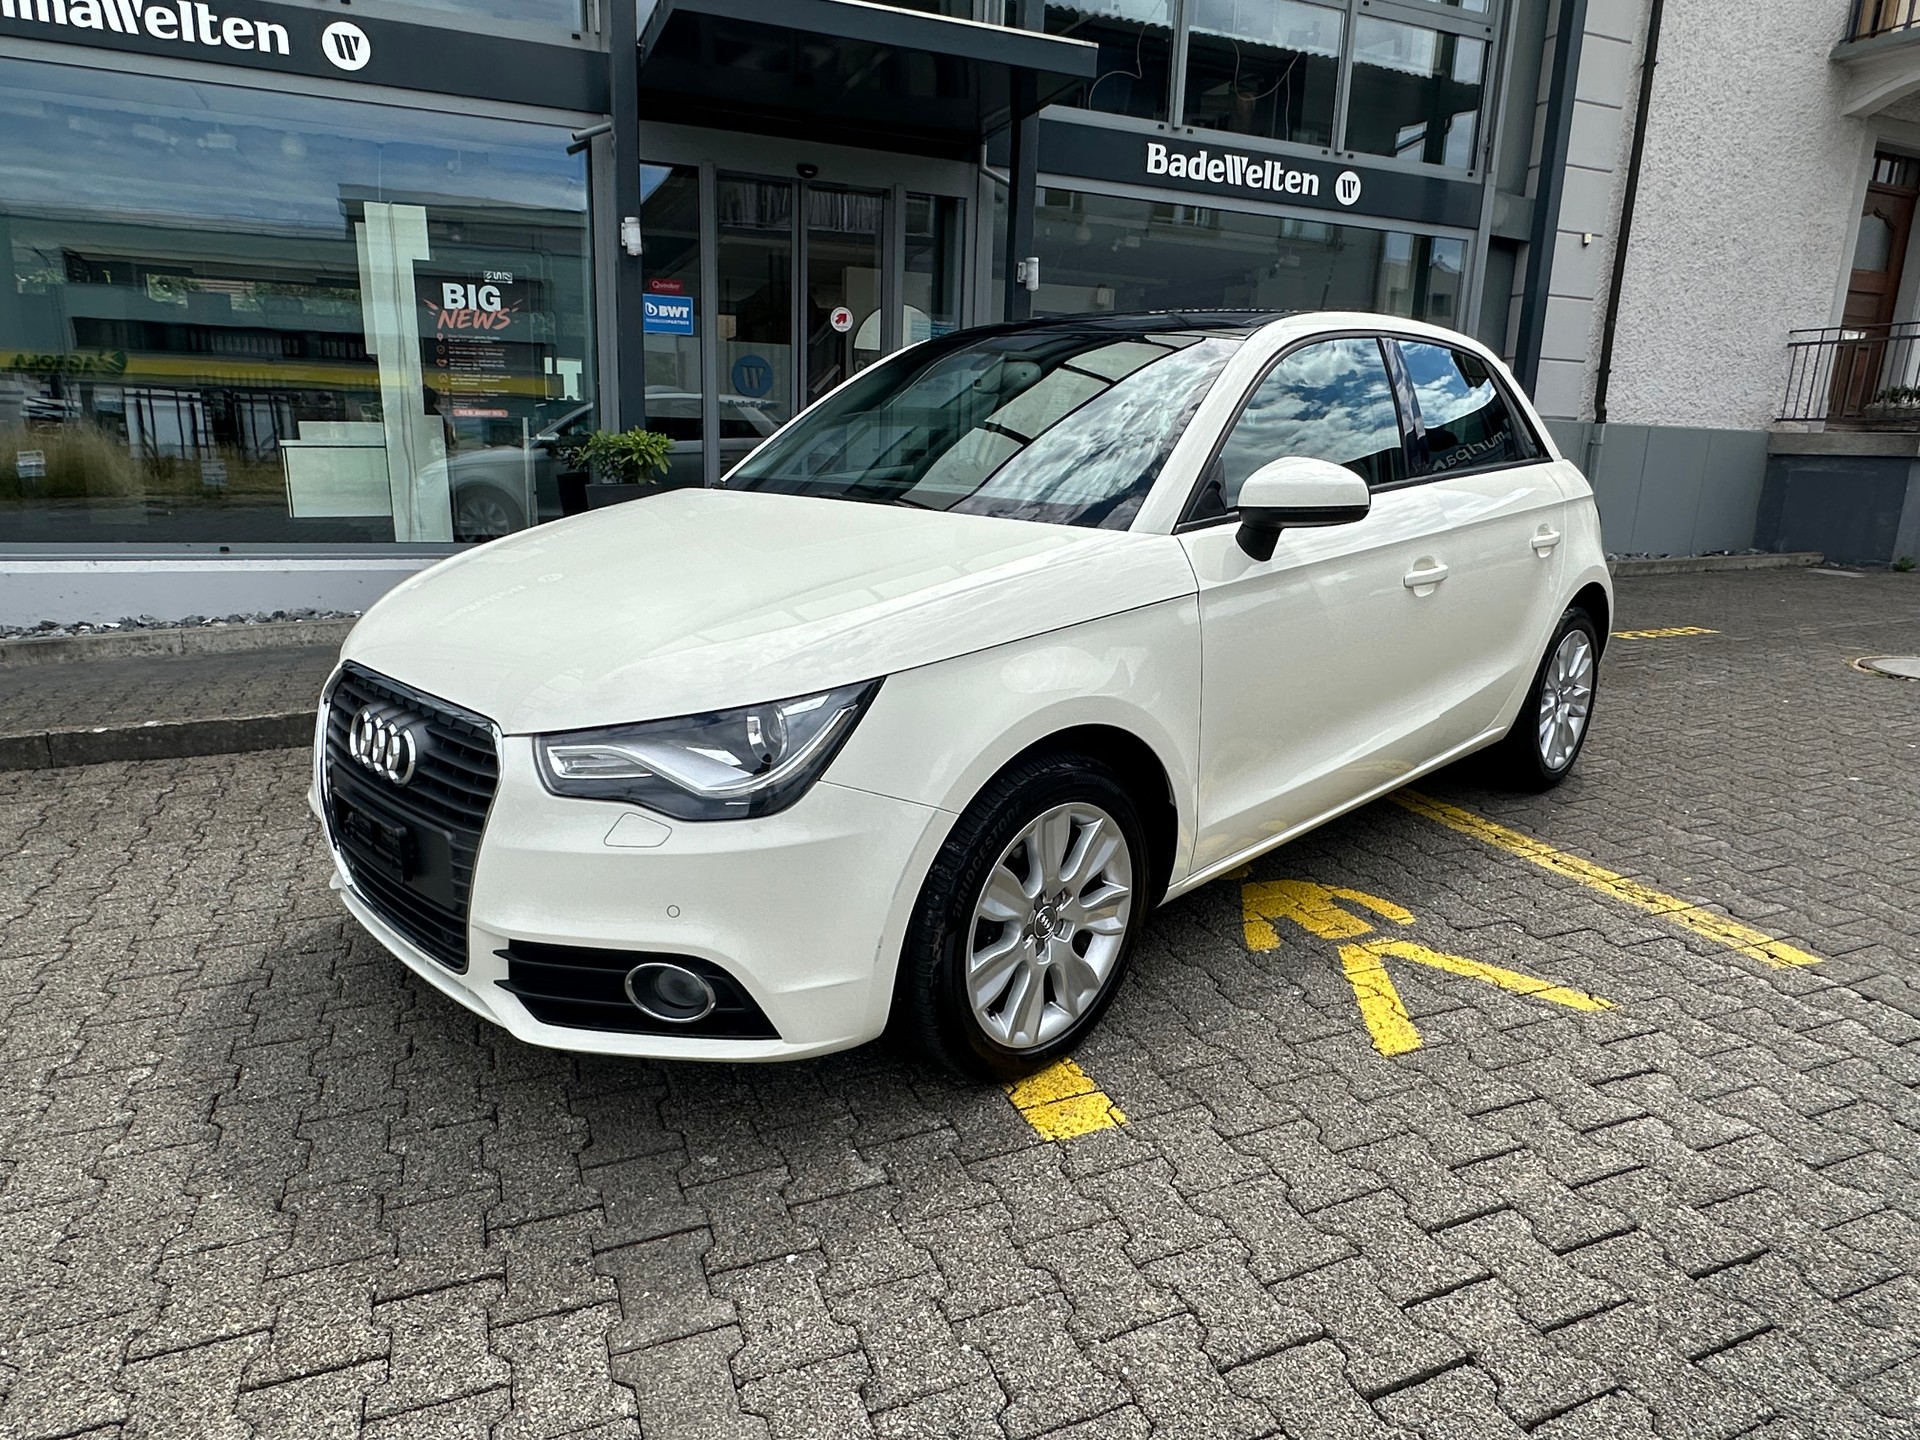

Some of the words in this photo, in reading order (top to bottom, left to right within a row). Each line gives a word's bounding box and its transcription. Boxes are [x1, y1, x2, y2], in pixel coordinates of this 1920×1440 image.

[1146, 142, 1320, 196] BadeWelten
[442, 282, 501, 312] BIG
[437, 307, 511, 330] NEWS
[658, 305, 689, 318] BWT
